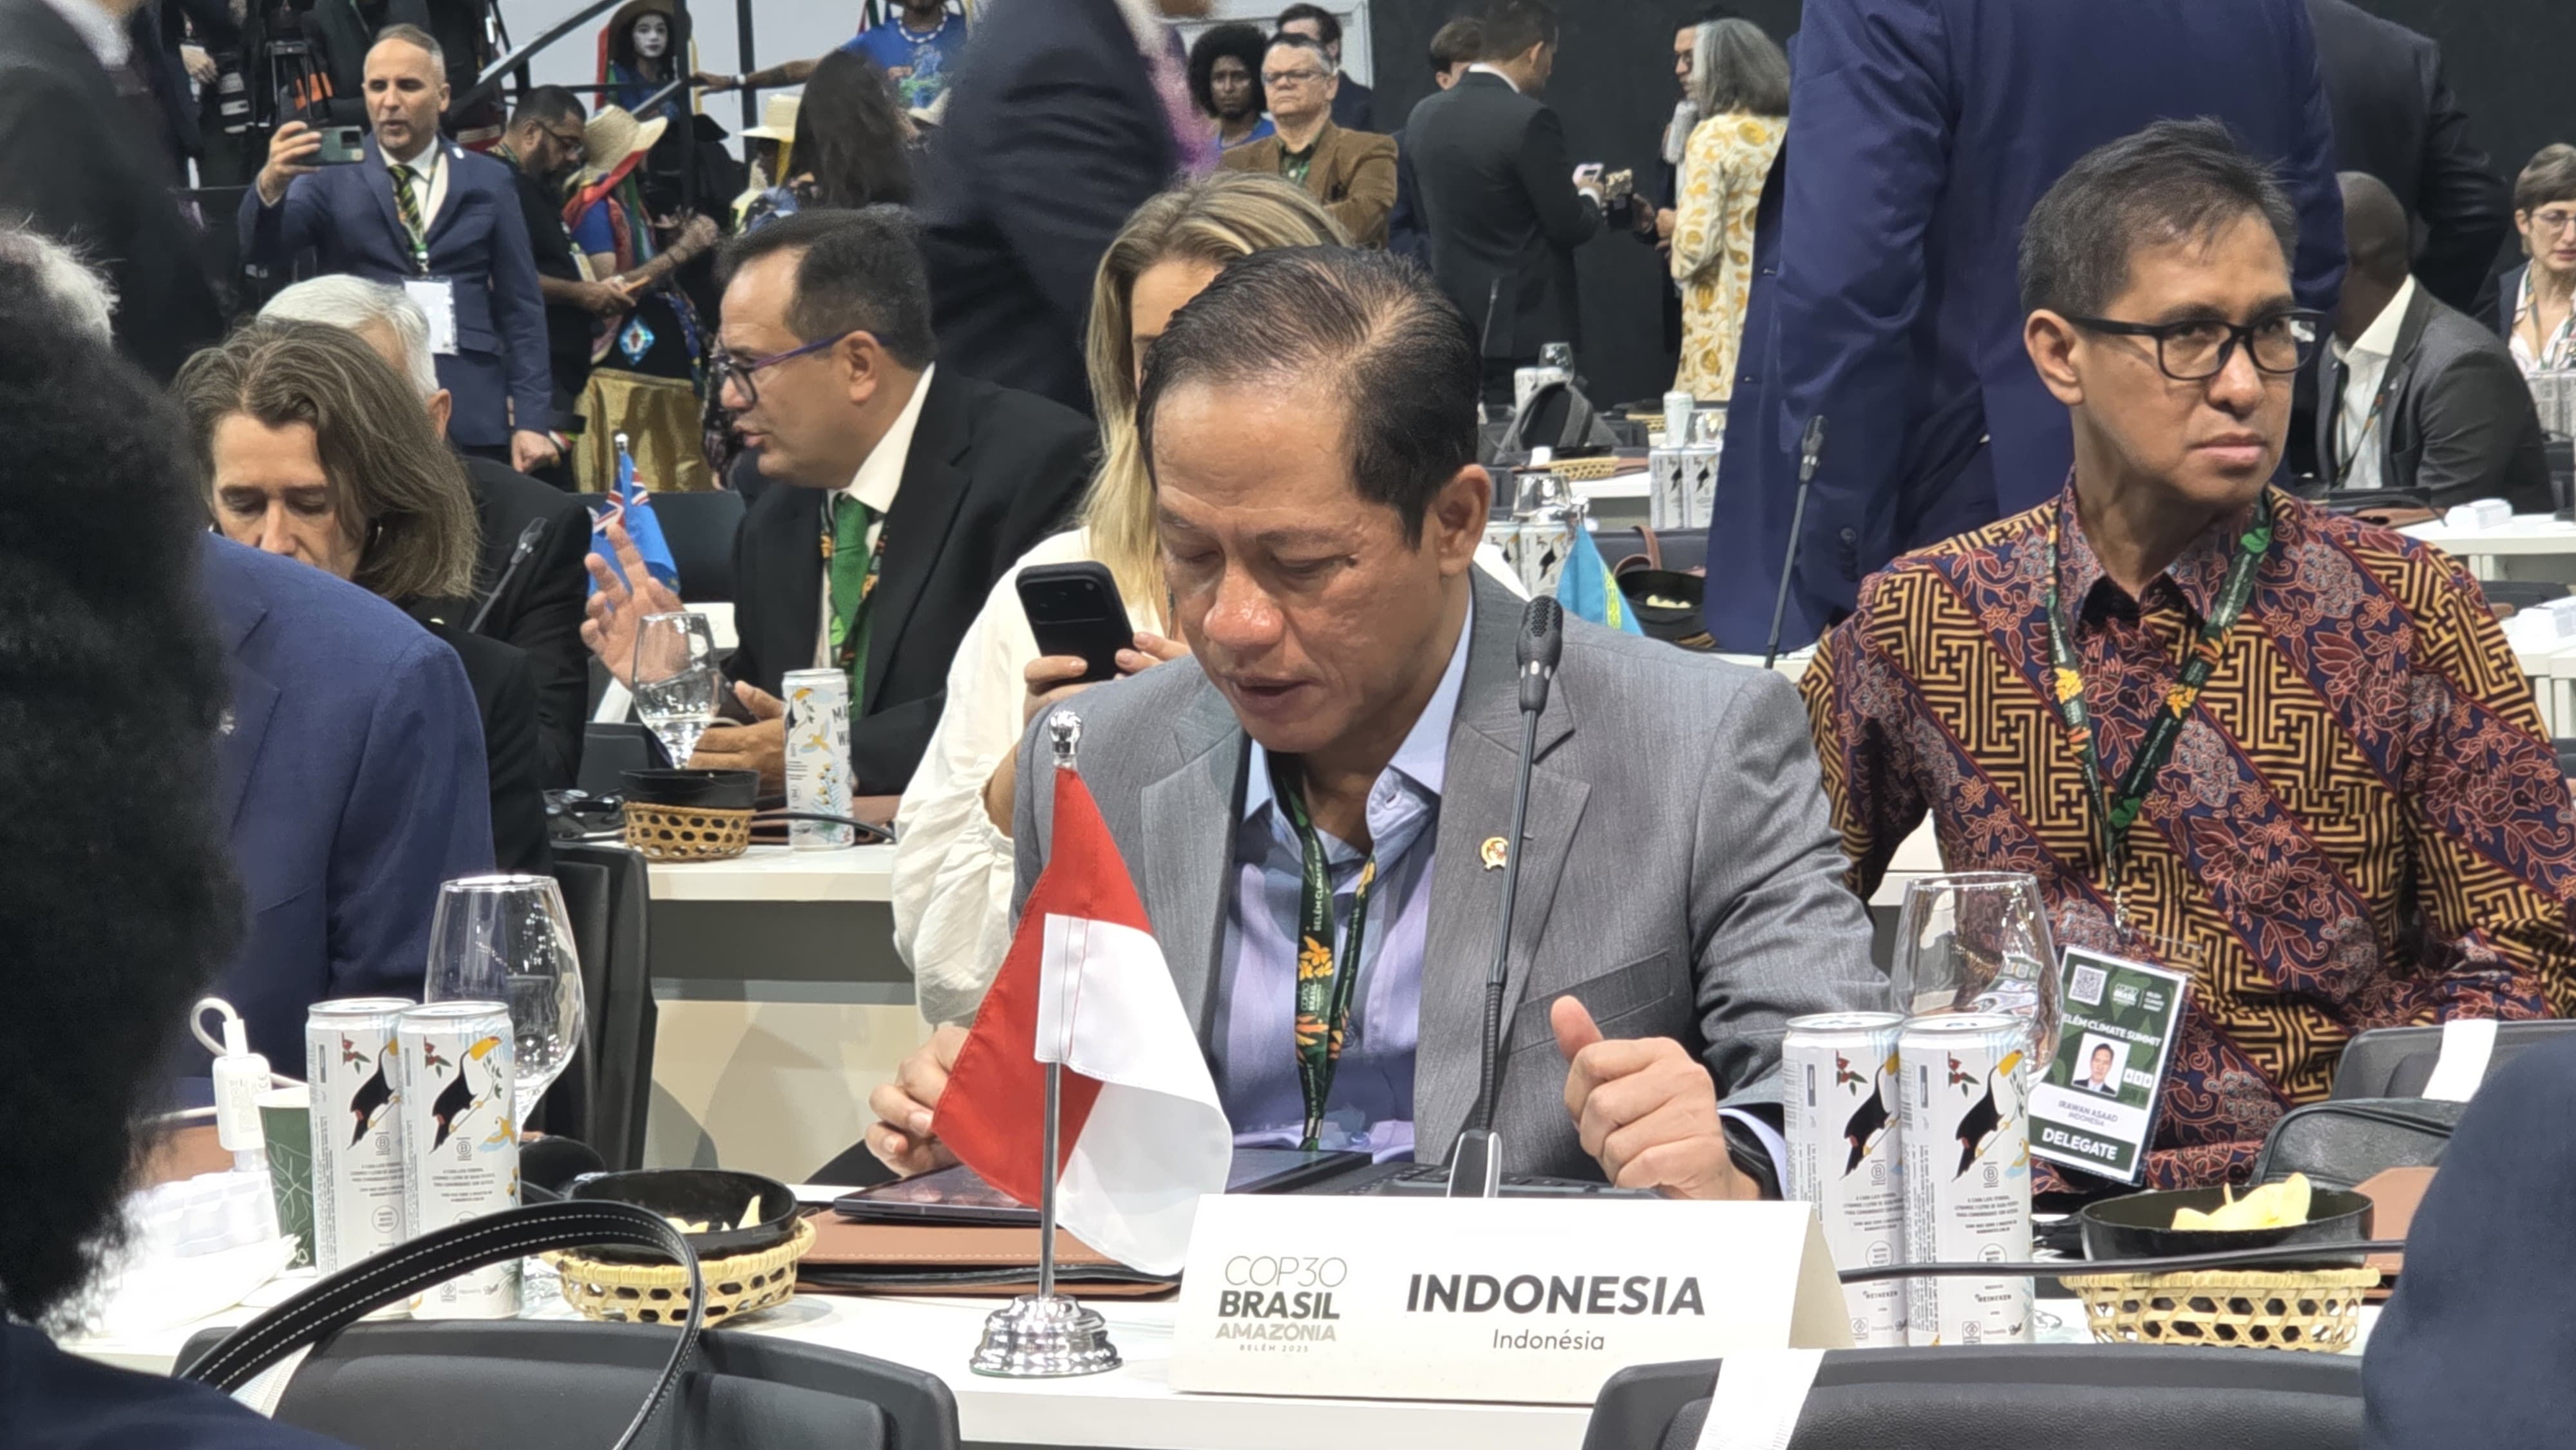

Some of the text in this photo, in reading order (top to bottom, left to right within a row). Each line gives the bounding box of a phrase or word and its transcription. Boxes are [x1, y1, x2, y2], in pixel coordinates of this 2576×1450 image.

[1314, 862, 1323, 900] CLIMATE
[1312, 901, 1323, 931] BELÉM
[2061, 1013, 2162, 1047] ELÉM CLIMATE SUMMIT
[2058, 1100, 2118, 1122] IRAWAN ASAAD
[2042, 1128, 2118, 1160] DELEGATE
[1225, 1255, 1347, 1288] COP30
[1218, 1290, 1340, 1320] BRASIL
[1406, 1274, 1705, 1316] INDONESIA
[1215, 1321, 1337, 1342] AMAZÔNIA
[1492, 1328, 1605, 1351] Indonésia
[1239, 1343, 1276, 1352] BELÉM
